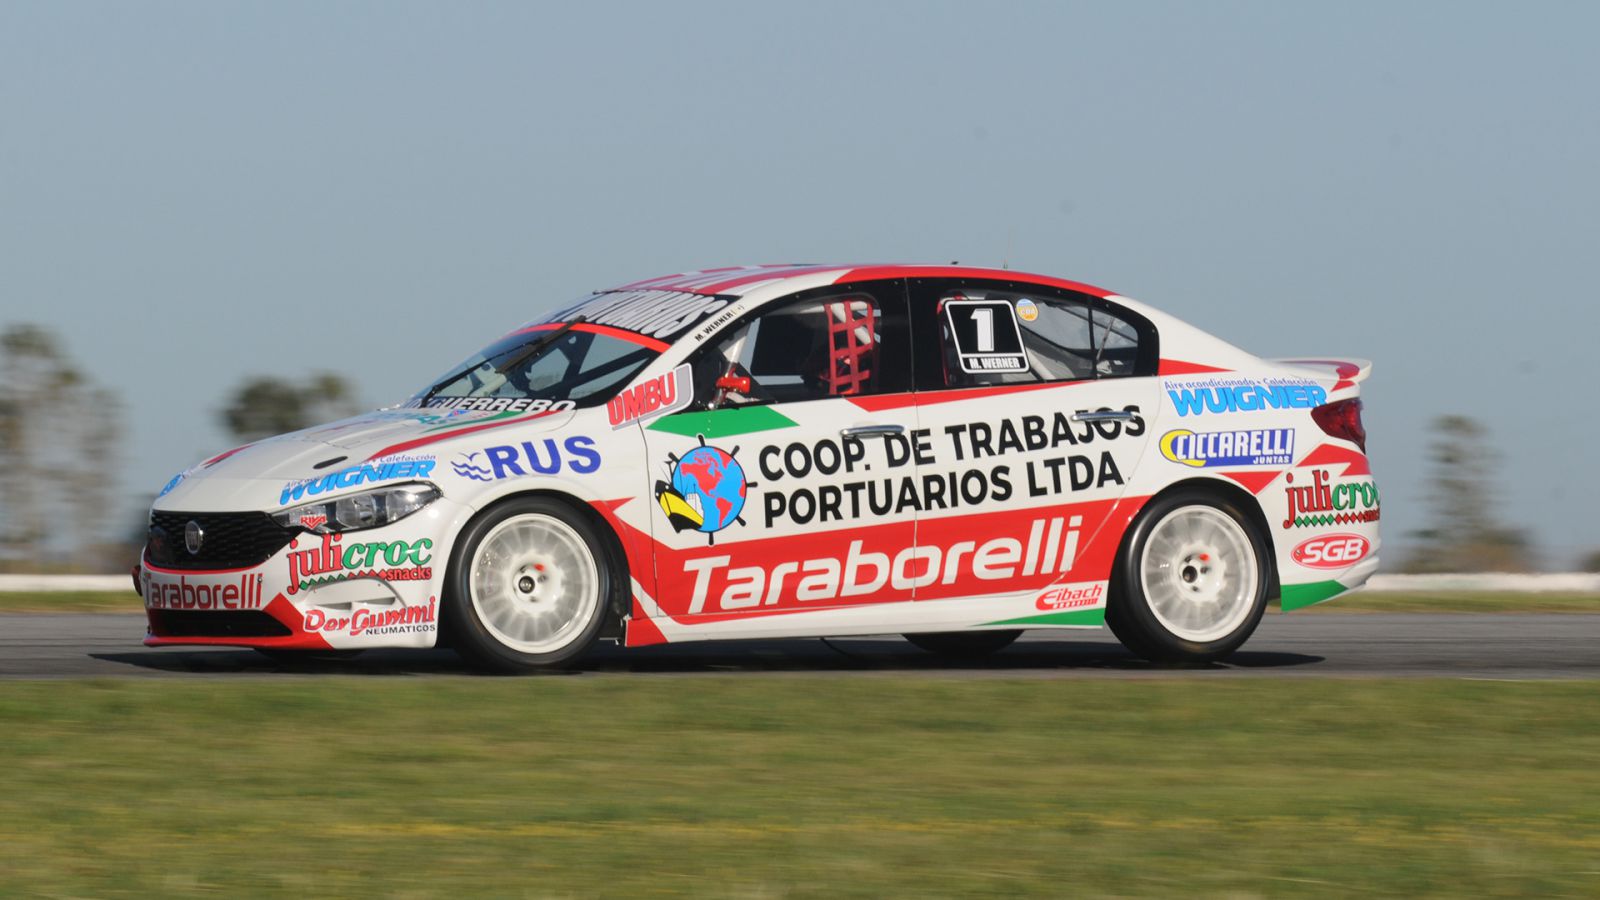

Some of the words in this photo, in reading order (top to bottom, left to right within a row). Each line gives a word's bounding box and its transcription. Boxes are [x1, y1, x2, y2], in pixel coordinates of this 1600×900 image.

[694, 333, 706, 342] M.
[703, 311, 734, 335] WERNER
[970, 308, 994, 352] 1
[969, 357, 983, 369] M.
[980, 357, 1020, 369] WERNER
[1168, 385, 1328, 418] WUIGNIER
[484, 435, 602, 482] RUS
[758, 432, 872, 482] COOP.
[884, 427, 936, 468] DE
[944, 404, 1146, 461] TRABAJOS
[1176, 428, 1294, 461] CICCARELLI
[1252, 455, 1290, 465] JUNTAS
[279, 460, 436, 505] WUIGNIER
[763, 464, 1013, 529] PORTUARIOS
[1026, 450, 1125, 498] LTDA
[1282, 469, 1380, 529] julicro
[287, 532, 433, 595] julicroc
[682, 514, 1083, 615] Taraborelli
[1301, 539, 1364, 563] SGB
[386, 567, 432, 581] snacks
[1035, 584, 1103, 611] Eibach
[365, 624, 436, 636] NEUMATICOS
